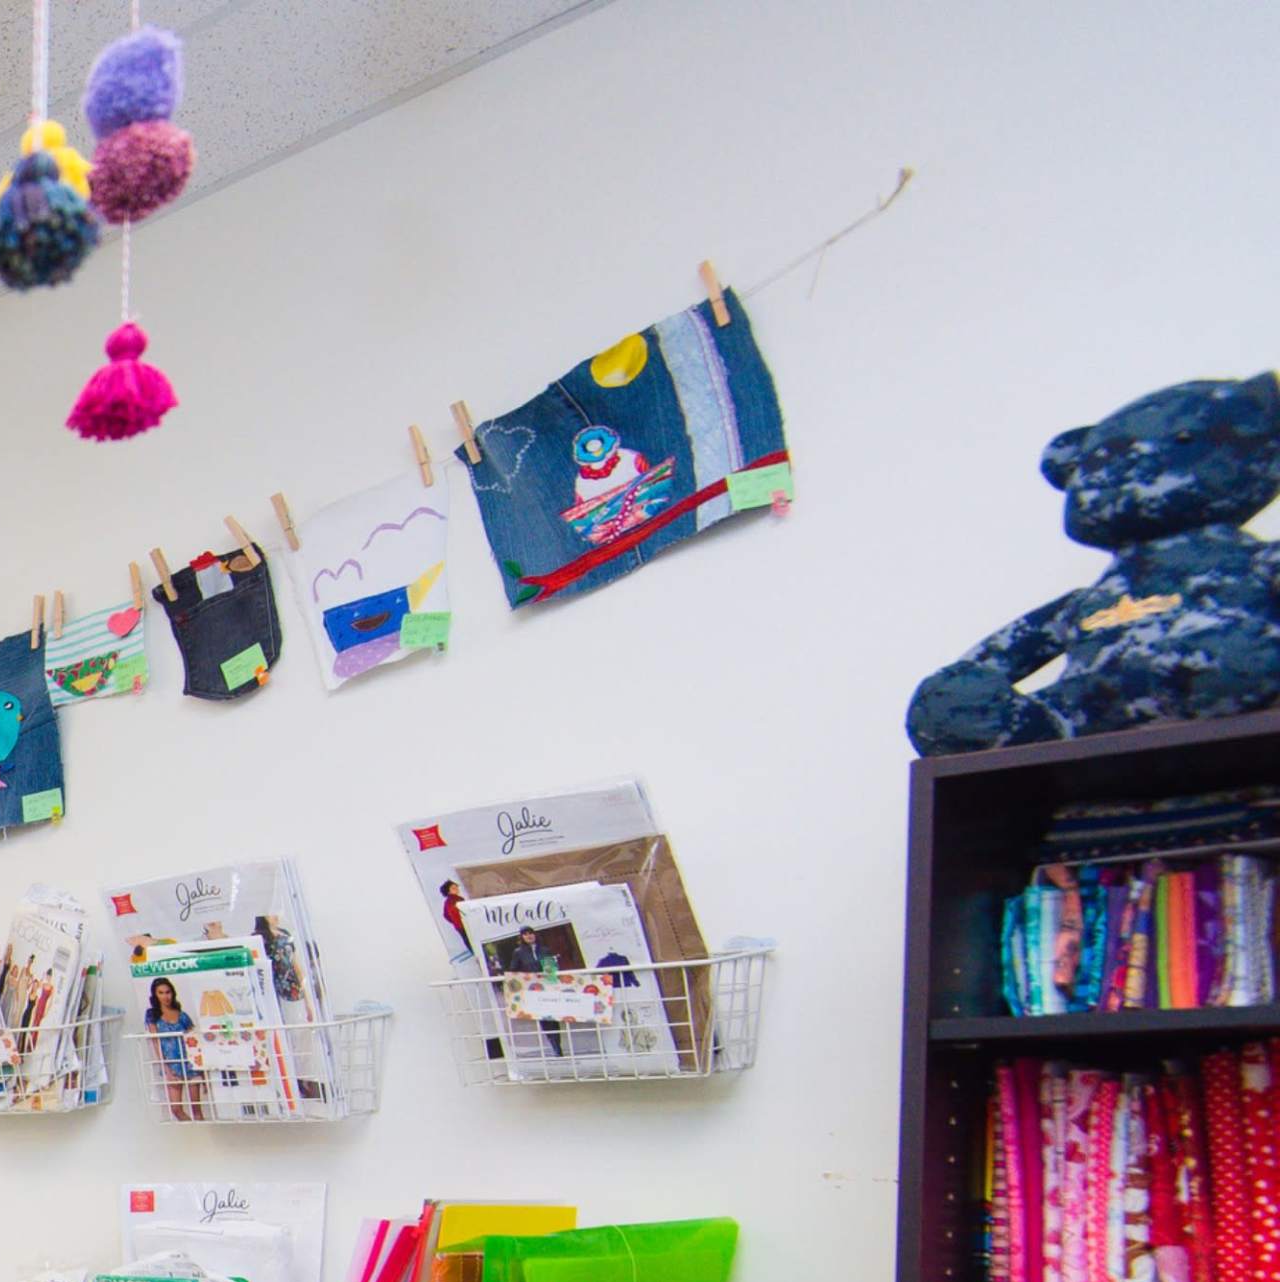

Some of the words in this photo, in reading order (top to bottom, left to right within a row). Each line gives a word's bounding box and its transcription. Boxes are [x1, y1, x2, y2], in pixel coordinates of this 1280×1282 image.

[497, 807, 552, 855] Jalie
[176, 878, 222, 922] Jalie
[200, 1189, 250, 1223] Jalie
